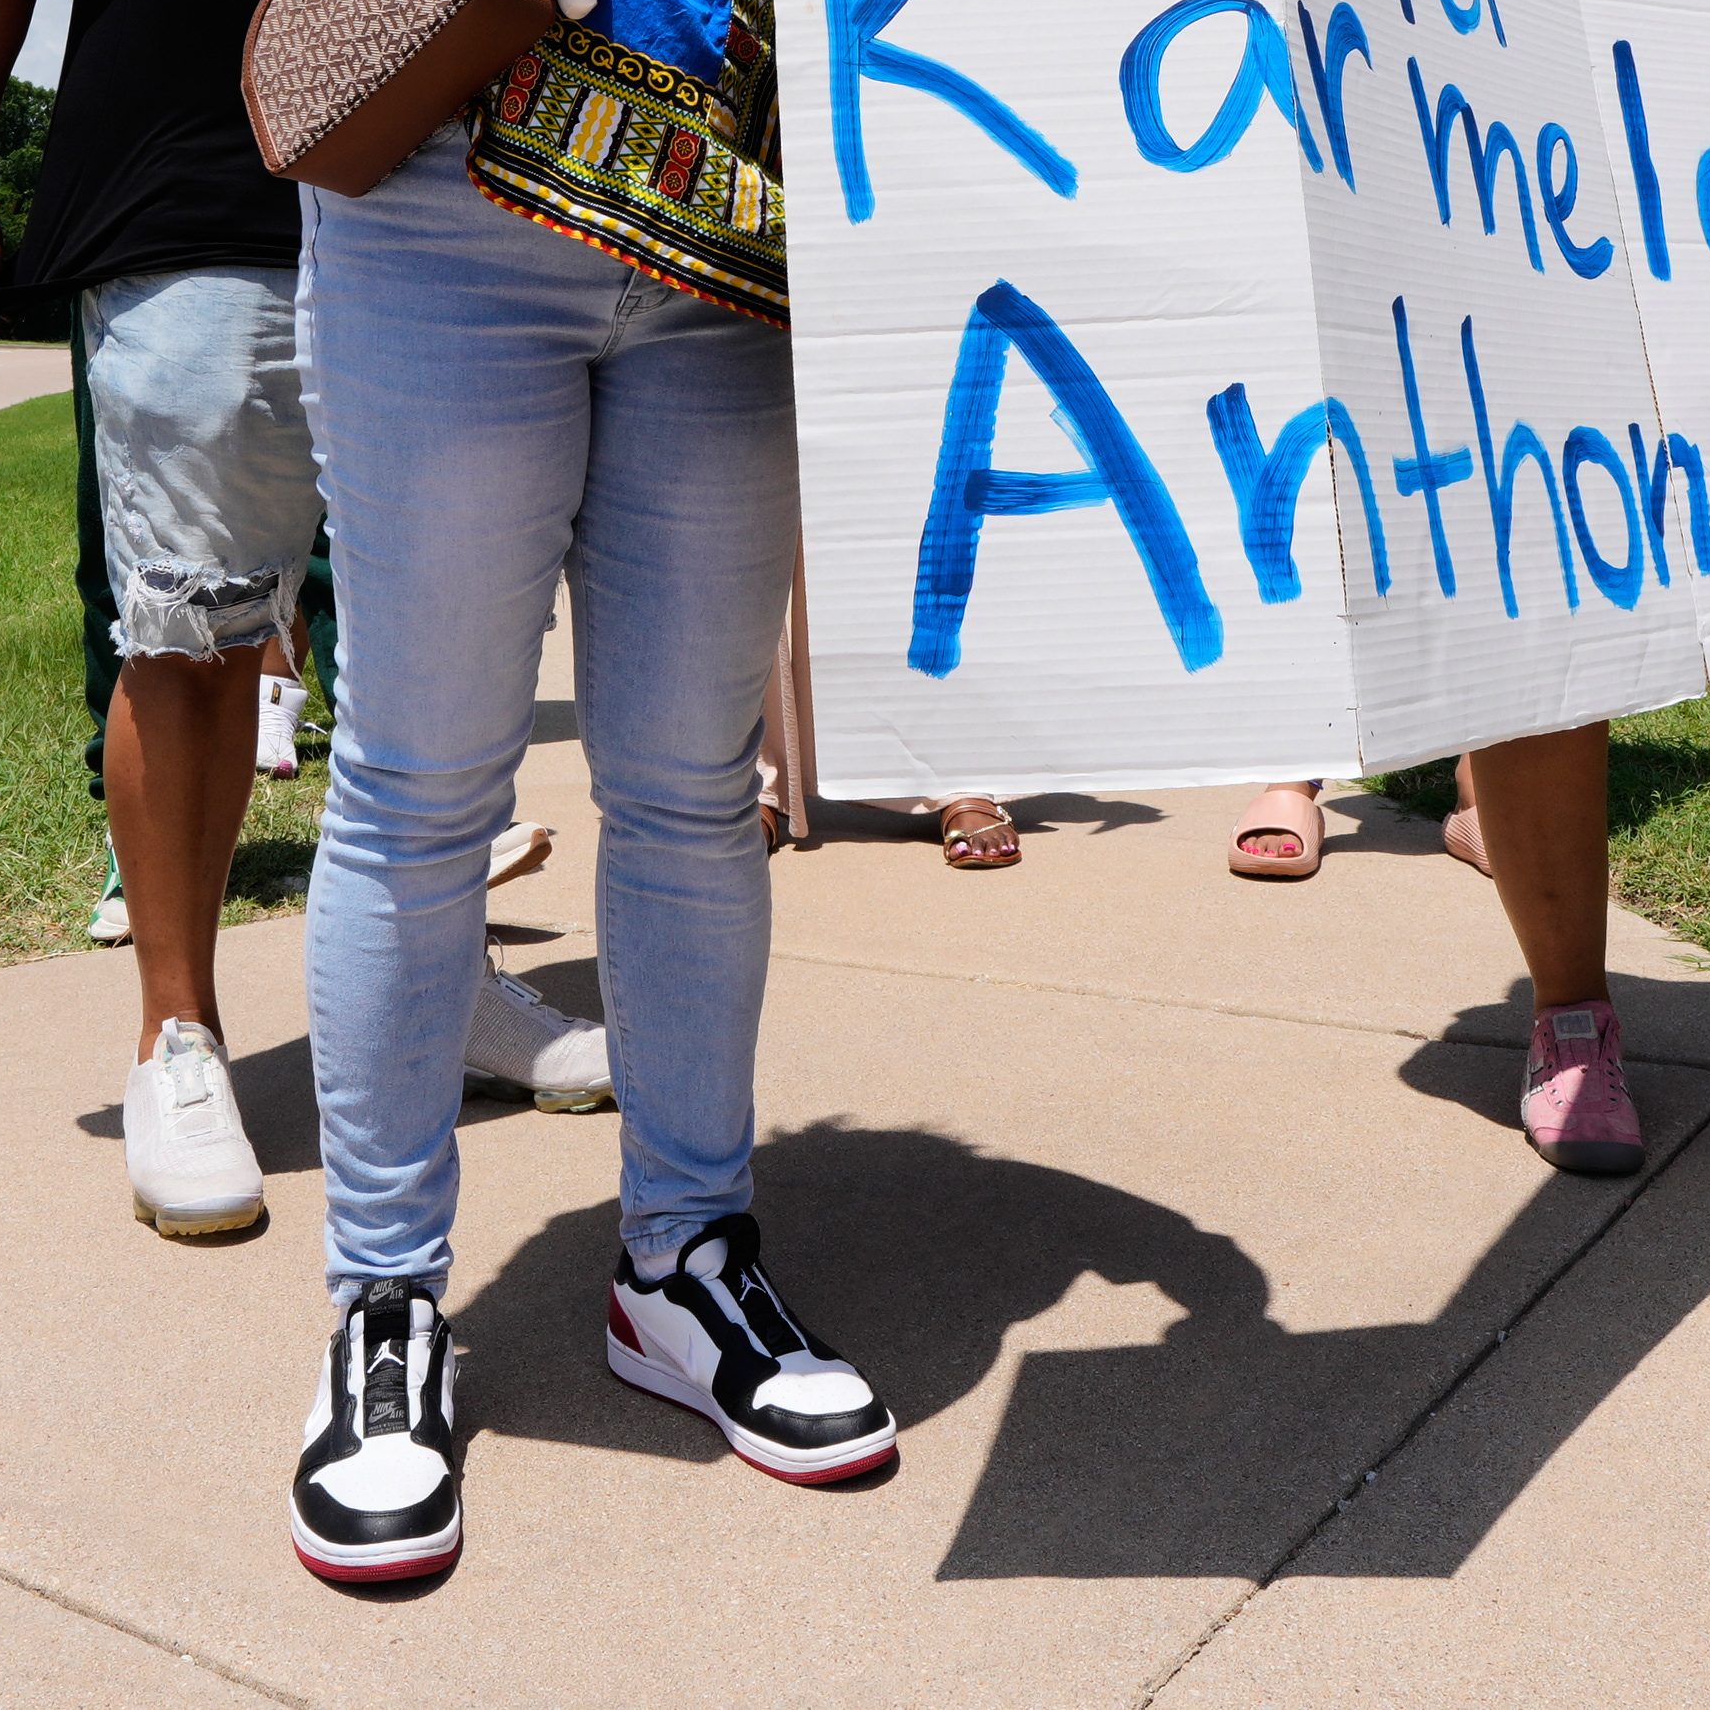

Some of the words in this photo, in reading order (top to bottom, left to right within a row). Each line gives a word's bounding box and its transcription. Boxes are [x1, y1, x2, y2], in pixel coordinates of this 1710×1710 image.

[372, 1279, 394, 1294] NIKE
[389, 1288, 404, 1300] AIR
[372, 1402, 396, 1415] NIKE
